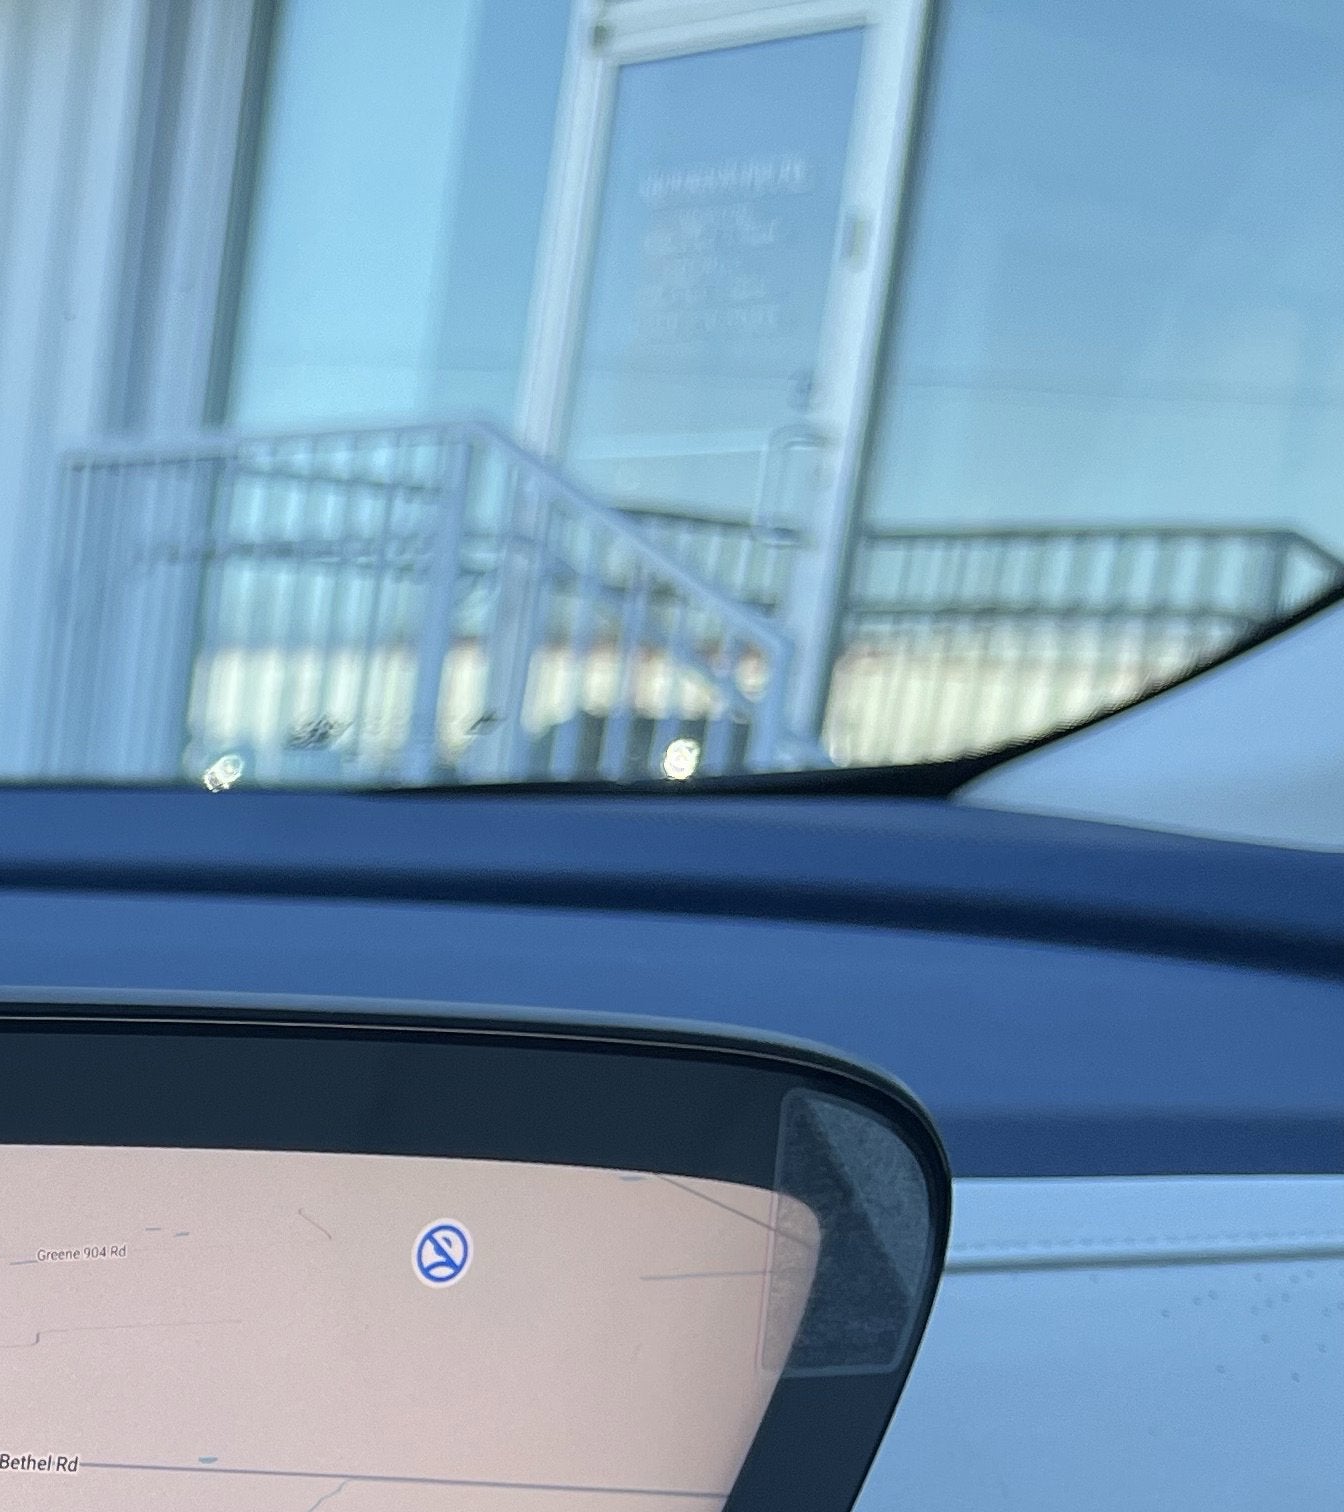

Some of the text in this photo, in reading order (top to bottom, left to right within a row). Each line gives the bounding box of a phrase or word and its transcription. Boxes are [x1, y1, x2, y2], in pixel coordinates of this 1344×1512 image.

[37, 1245, 126, 1261] Greene 904 Rd
[56, 1456, 79, 1474] Rd
